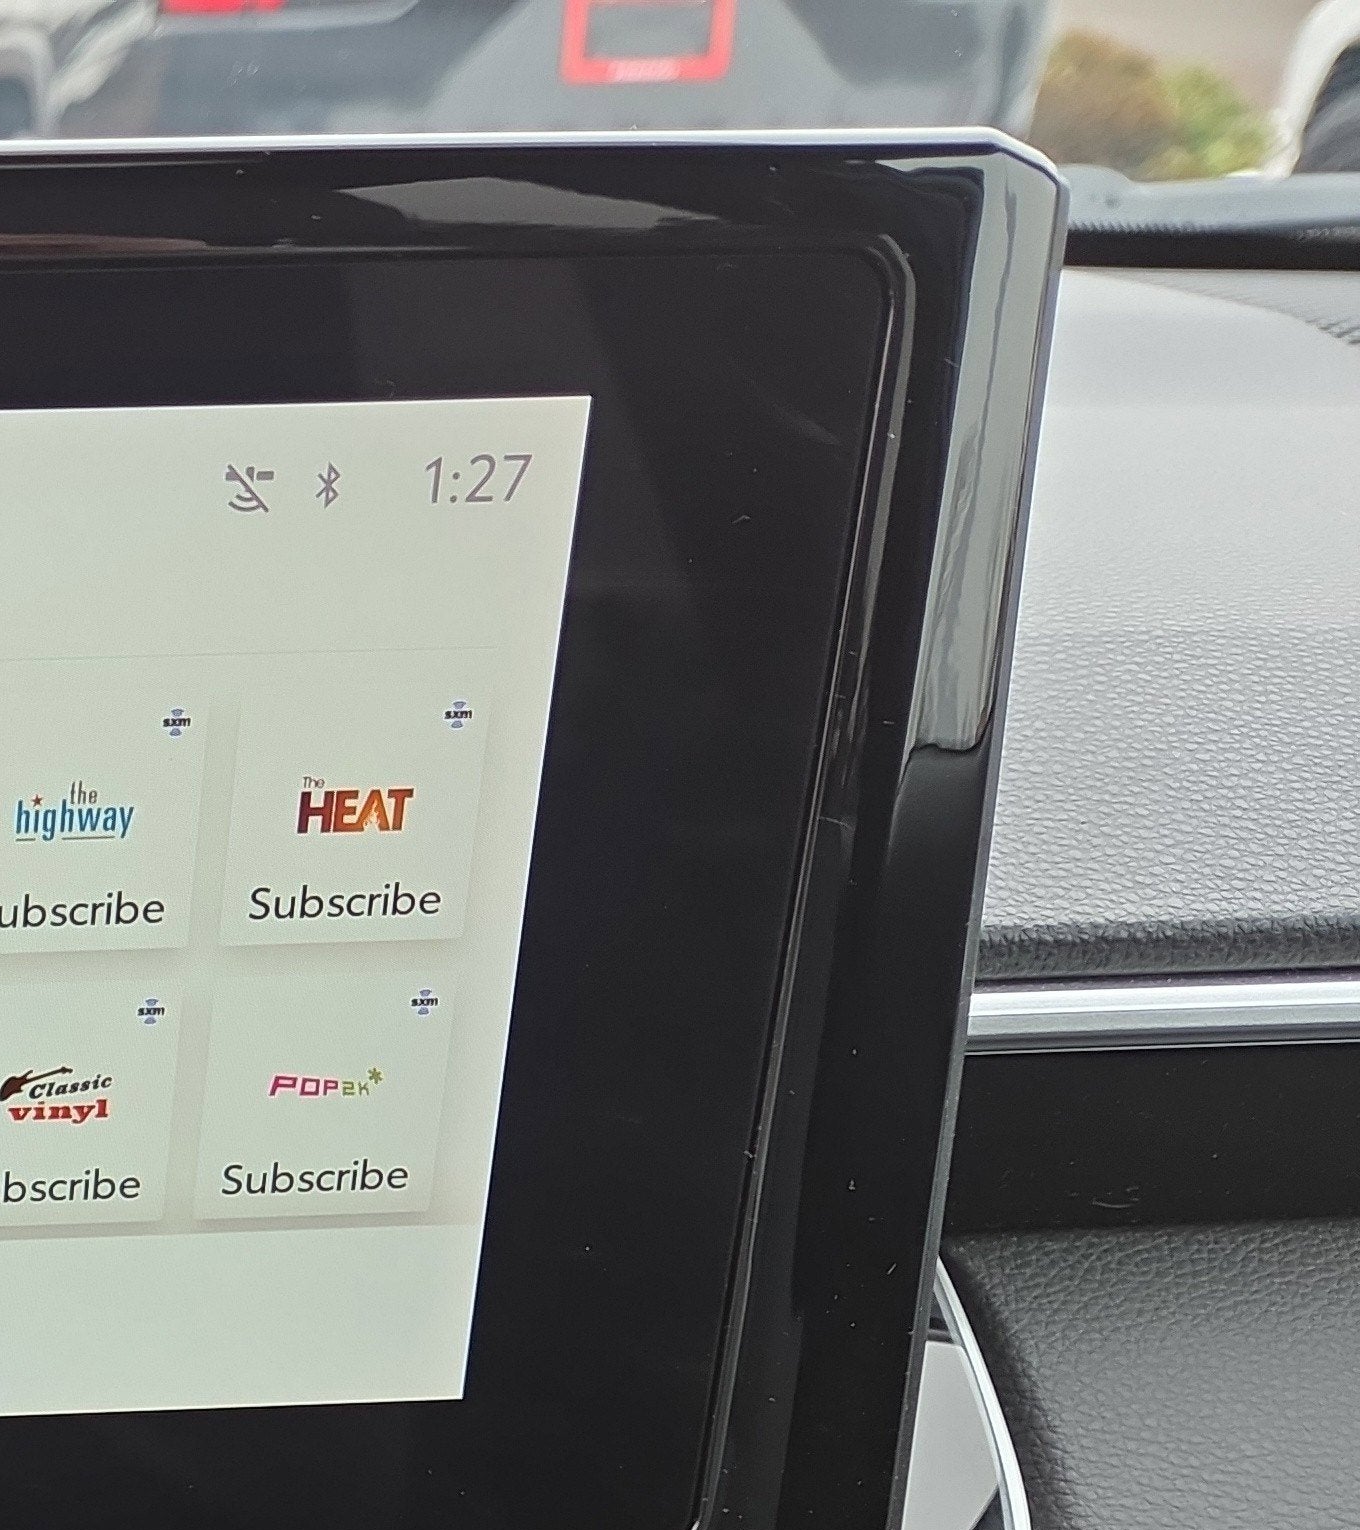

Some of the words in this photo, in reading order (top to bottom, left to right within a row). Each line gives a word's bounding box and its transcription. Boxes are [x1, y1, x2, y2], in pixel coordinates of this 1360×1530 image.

[425, 452, 533, 504] 1:27
[70, 780, 98, 804] the
[303, 776, 325, 789] The
[15, 796, 135, 842] highway
[297, 788, 414, 834] HEAT
[249, 882, 443, 921] Subscribe
[28, 1073, 113, 1100] Classic
[7, 1098, 109, 1125] vinyl
[220, 1159, 410, 1196] Subscribe
